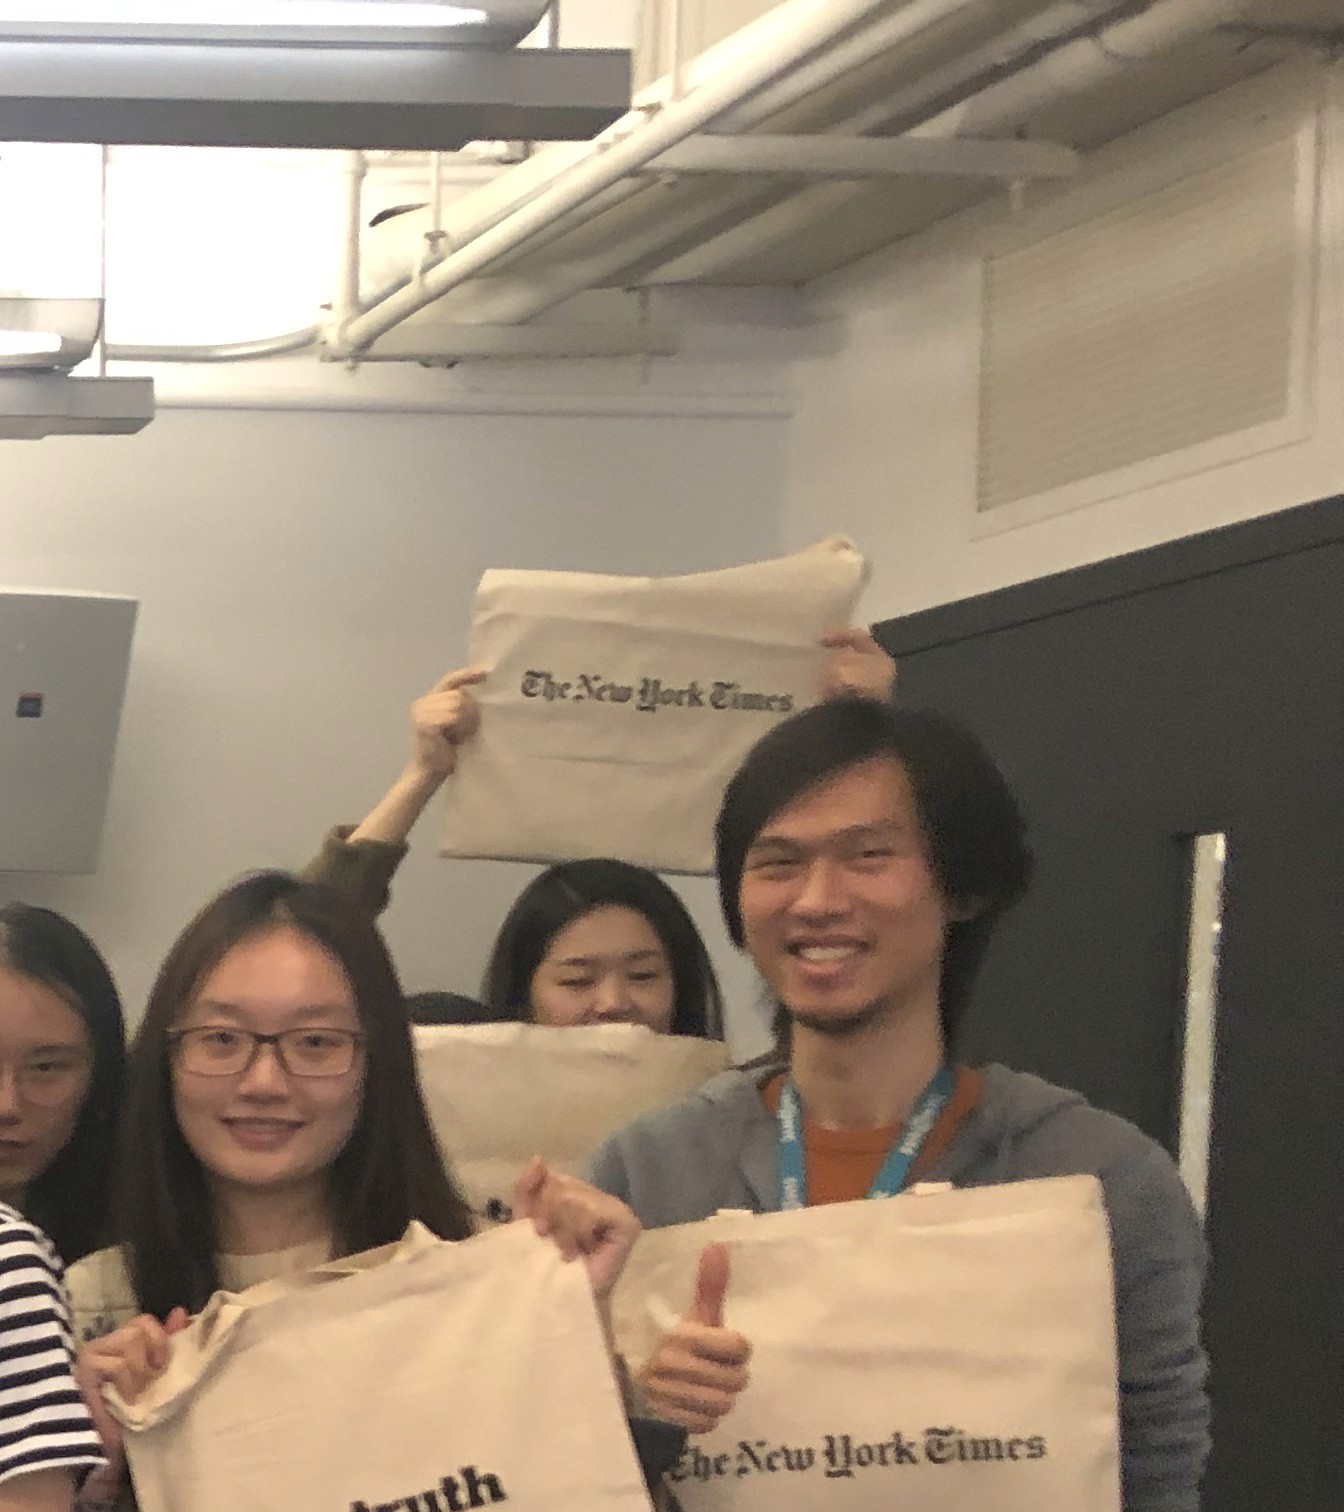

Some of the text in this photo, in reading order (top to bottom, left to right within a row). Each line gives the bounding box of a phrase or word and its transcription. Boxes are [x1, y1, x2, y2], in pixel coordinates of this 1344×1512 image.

[521, 669, 794, 713] The New York Times
[737, 1440, 816, 1477] New
[823, 1431, 919, 1478] York
[924, 1425, 1047, 1465] Times
